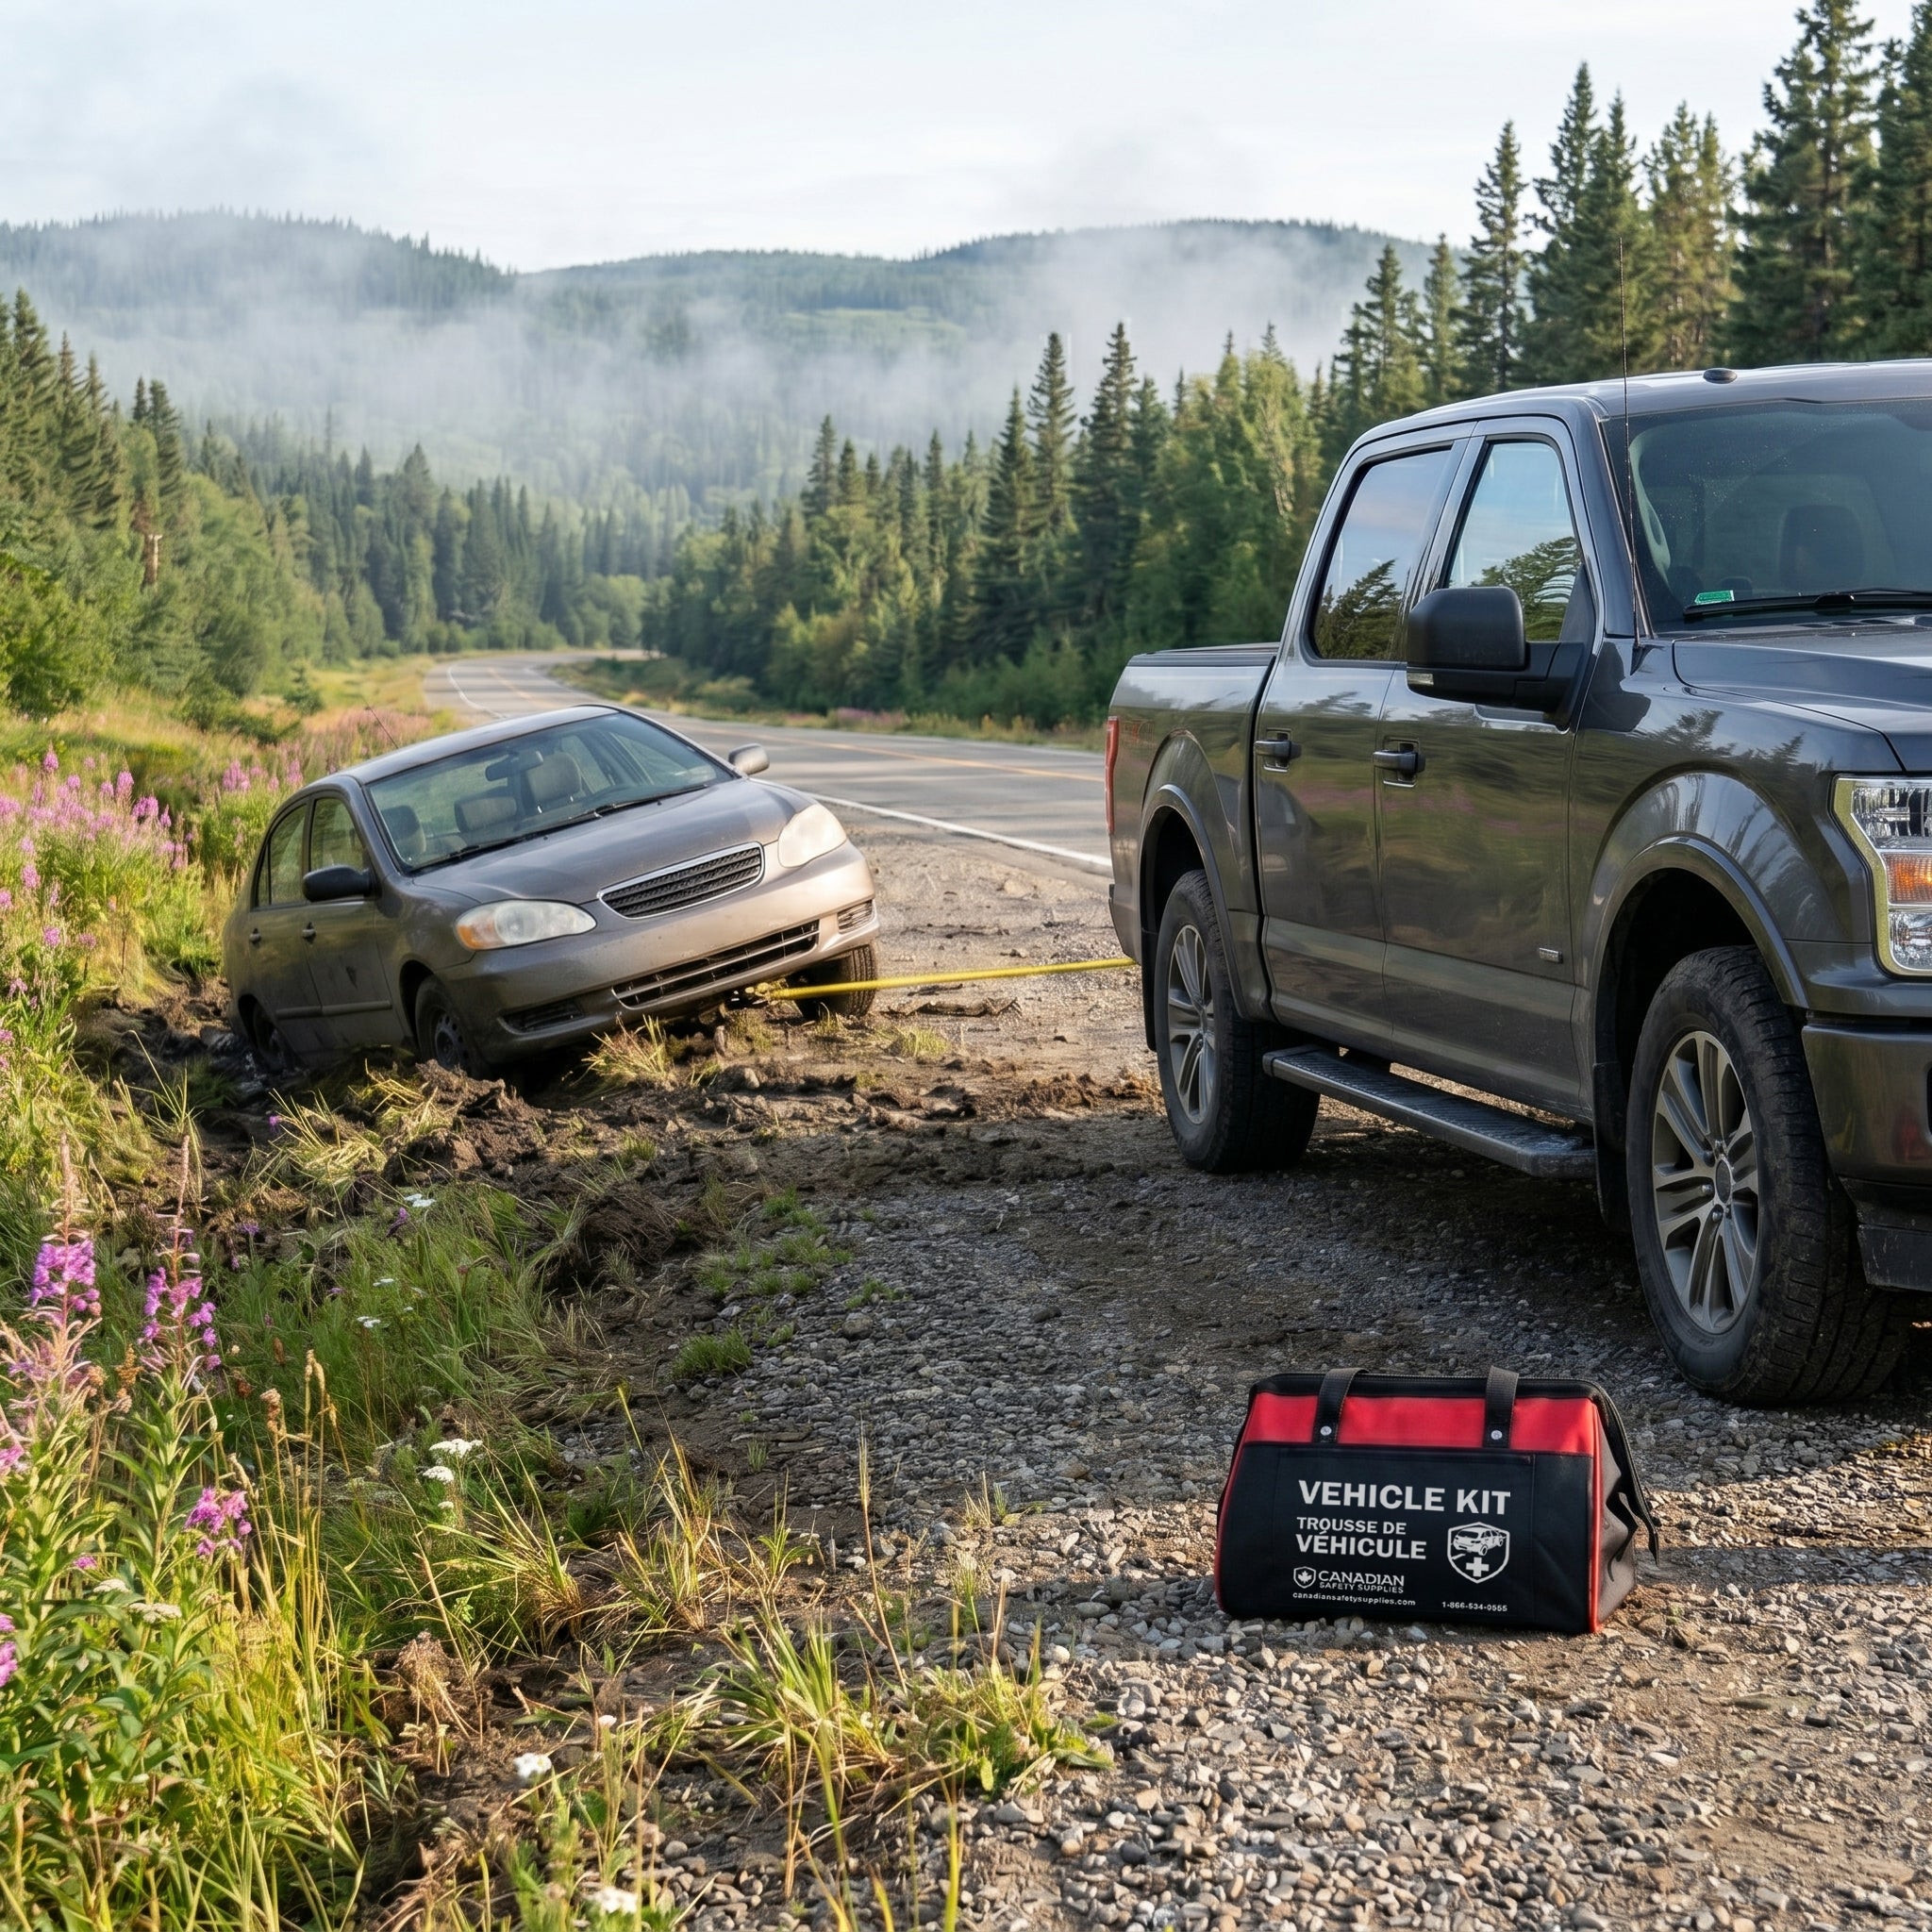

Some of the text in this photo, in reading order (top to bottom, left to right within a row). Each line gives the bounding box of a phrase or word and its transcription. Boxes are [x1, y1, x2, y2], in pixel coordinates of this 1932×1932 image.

[1298, 1479, 1511, 1515] VEHICLE KIT
[1296, 1516, 1407, 1536] TROUSSE DE
[1295, 1530, 1427, 1560] VÉHICULE
[1318, 1570, 1406, 1587] CANADIAN
[1319, 1581, 1405, 1594] SAFETY SUPPLIES
[1292, 1591, 1417, 1607] canadiansafetysupplies.com
